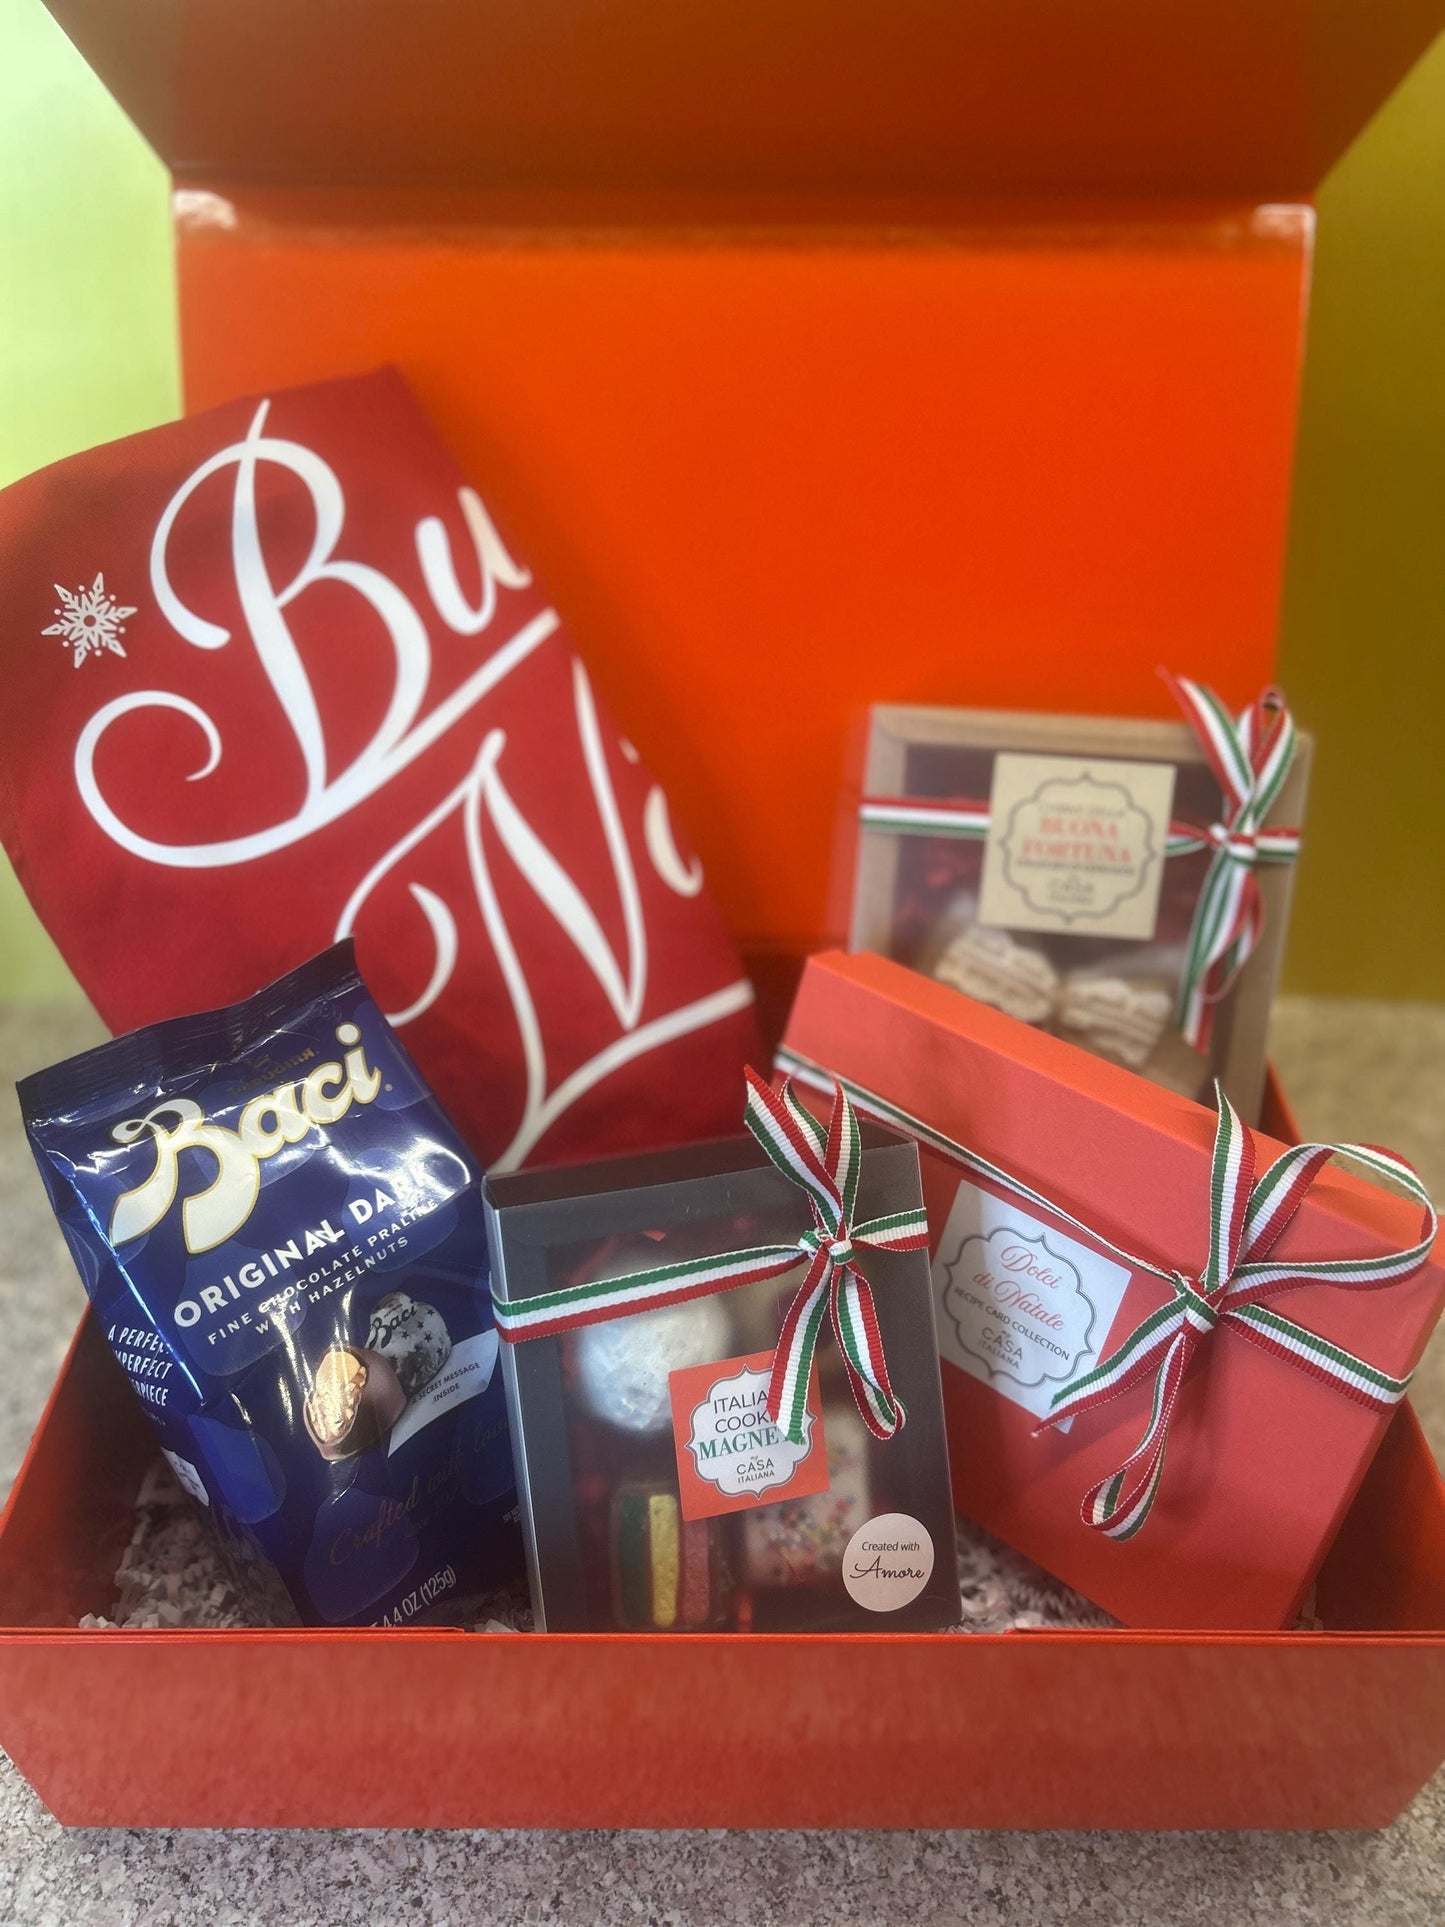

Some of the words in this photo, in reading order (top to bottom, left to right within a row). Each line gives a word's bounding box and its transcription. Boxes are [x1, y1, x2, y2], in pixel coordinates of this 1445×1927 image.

[109, 1021, 382, 1254] Baci
[174, 1219, 345, 1328] ORIGINAL
[308, 1236, 409, 1304] HAZELNUTS
[1000, 1245, 1061, 1289] Dolci
[207, 1312, 252, 1345] FINE
[258, 1245, 363, 1314] CHOCOLATE
[972, 1272, 993, 1289] di
[994, 1280, 1064, 1331] Natale
[108, 1324, 117, 1342] A
[368, 1299, 417, 1350] Baci
[954, 1287, 985, 1311] RECIPE
[985, 1303, 1011, 1326] CARD
[1011, 1320, 1070, 1361] COLLECTION
[978, 1339, 1020, 1370] ITALIANA
[981, 1326, 1023, 1360] CASA
[418, 1379, 442, 1401] SECRET
[443, 1362, 481, 1384] MESSAGE
[433, 1382, 461, 1402] INSIDE
[713, 1389, 769, 1414] ITALIA
[715, 1409, 775, 1434] COOK
[736, 1457, 774, 1475] CASA
[737, 1469, 775, 1484] ITALIANA
[861, 1541, 899, 1552] Created
[900, 1541, 920, 1552] with
[849, 1554, 925, 1579] Amore
[402, 1591, 422, 1617] OZ
[420, 1564, 457, 1606] (125g)
